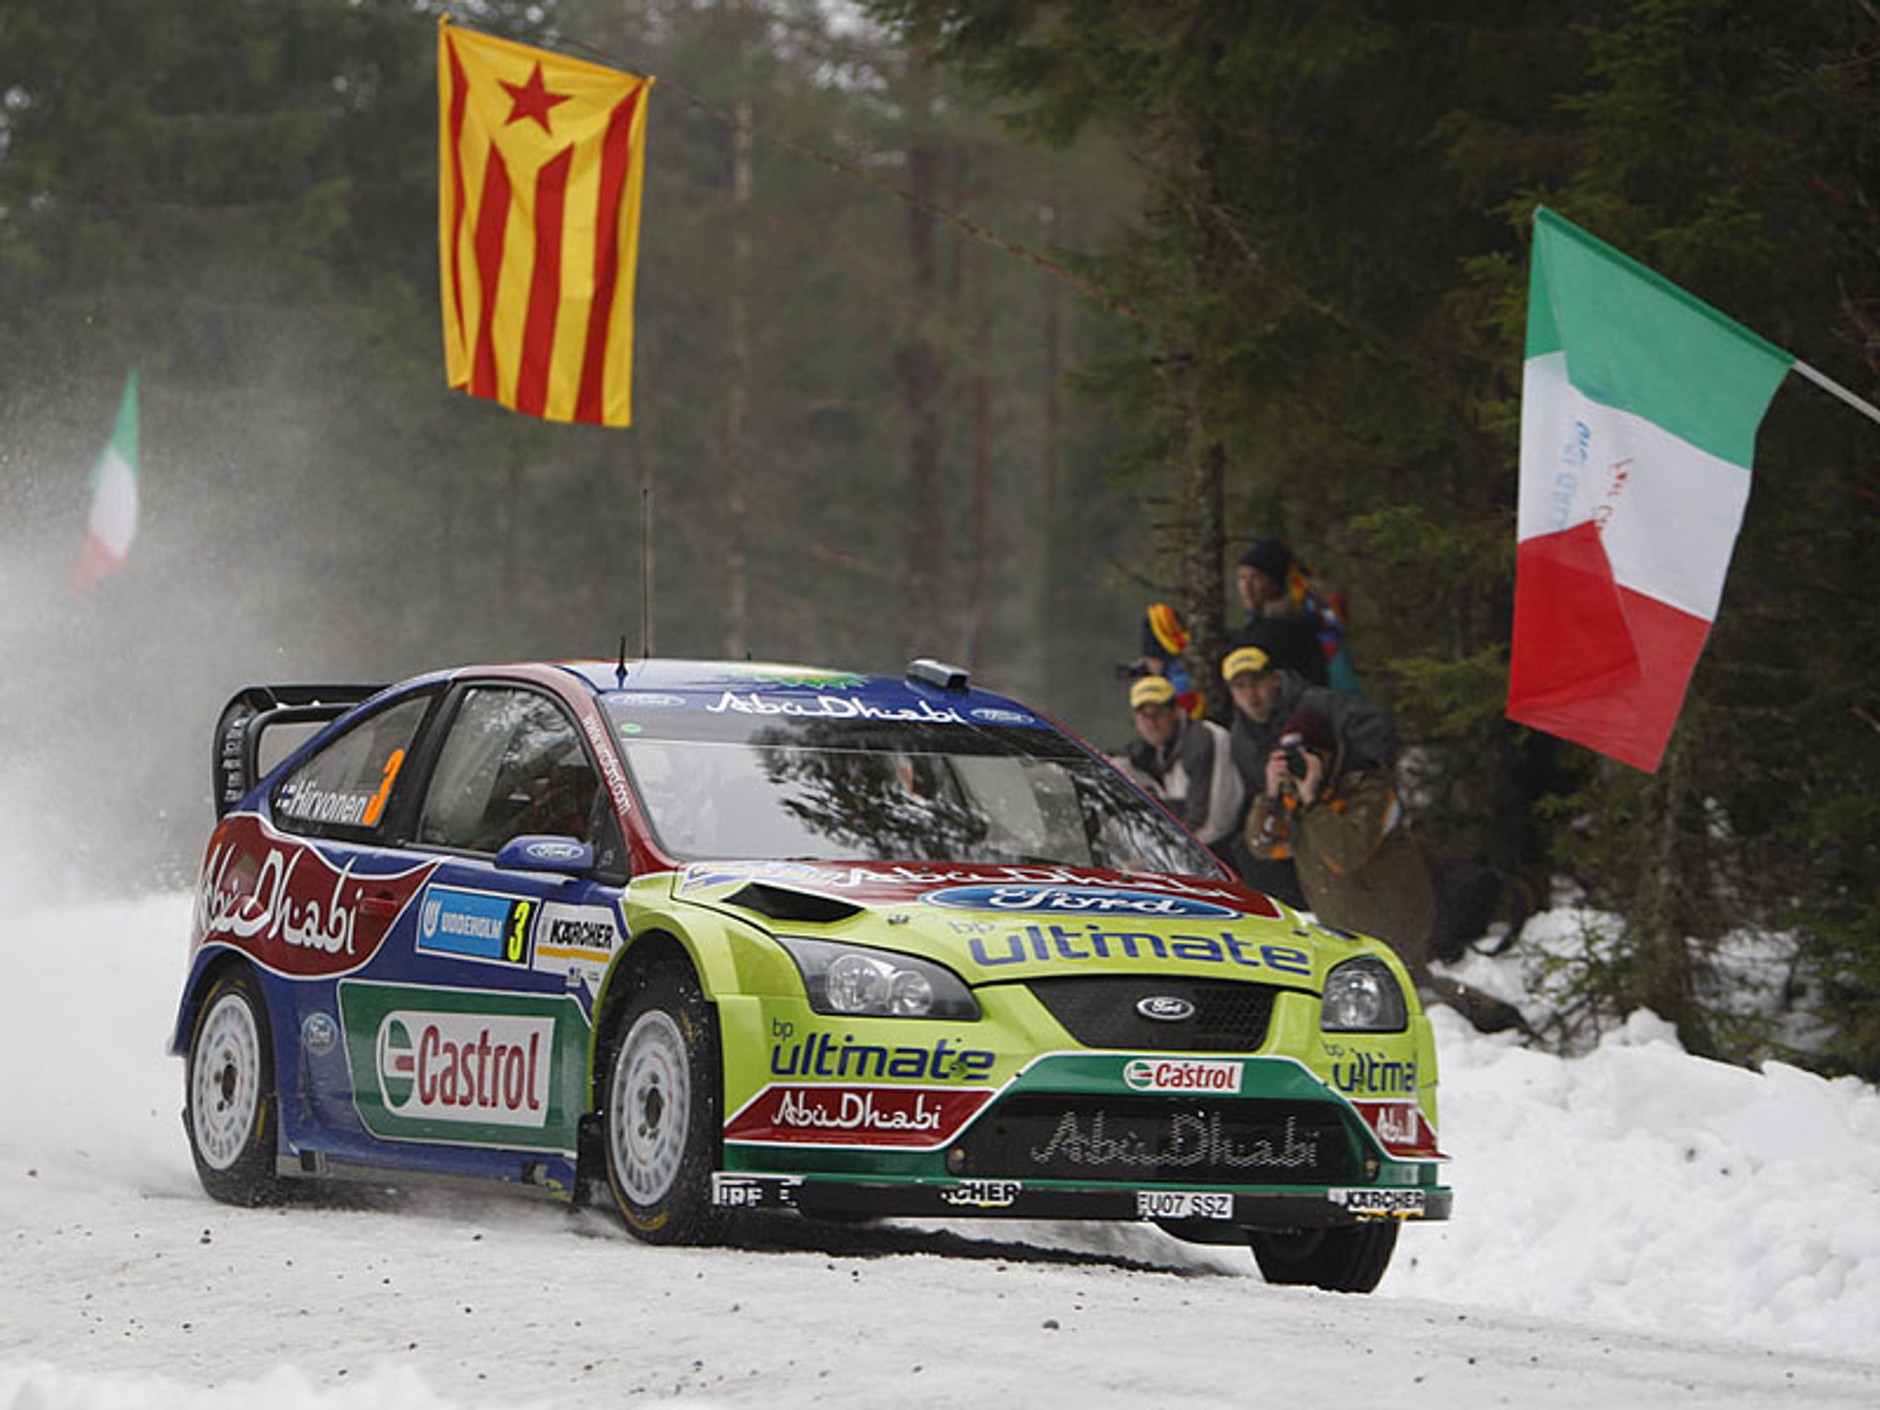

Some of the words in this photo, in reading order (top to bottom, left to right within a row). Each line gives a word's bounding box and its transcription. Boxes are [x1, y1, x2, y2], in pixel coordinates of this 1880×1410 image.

[287, 779, 368, 824] Hirvonen
[988, 885, 1187, 915] Ford
[507, 901, 530, 963] 3
[968, 924, 1312, 977] ultimate
[772, 1018, 794, 1041] bp
[417, 1024, 540, 1112] Castrol
[770, 1032, 997, 1081] ultimate
[1154, 1061, 1238, 1090] Castrol
[1190, 1195, 1229, 1216] SSZ
